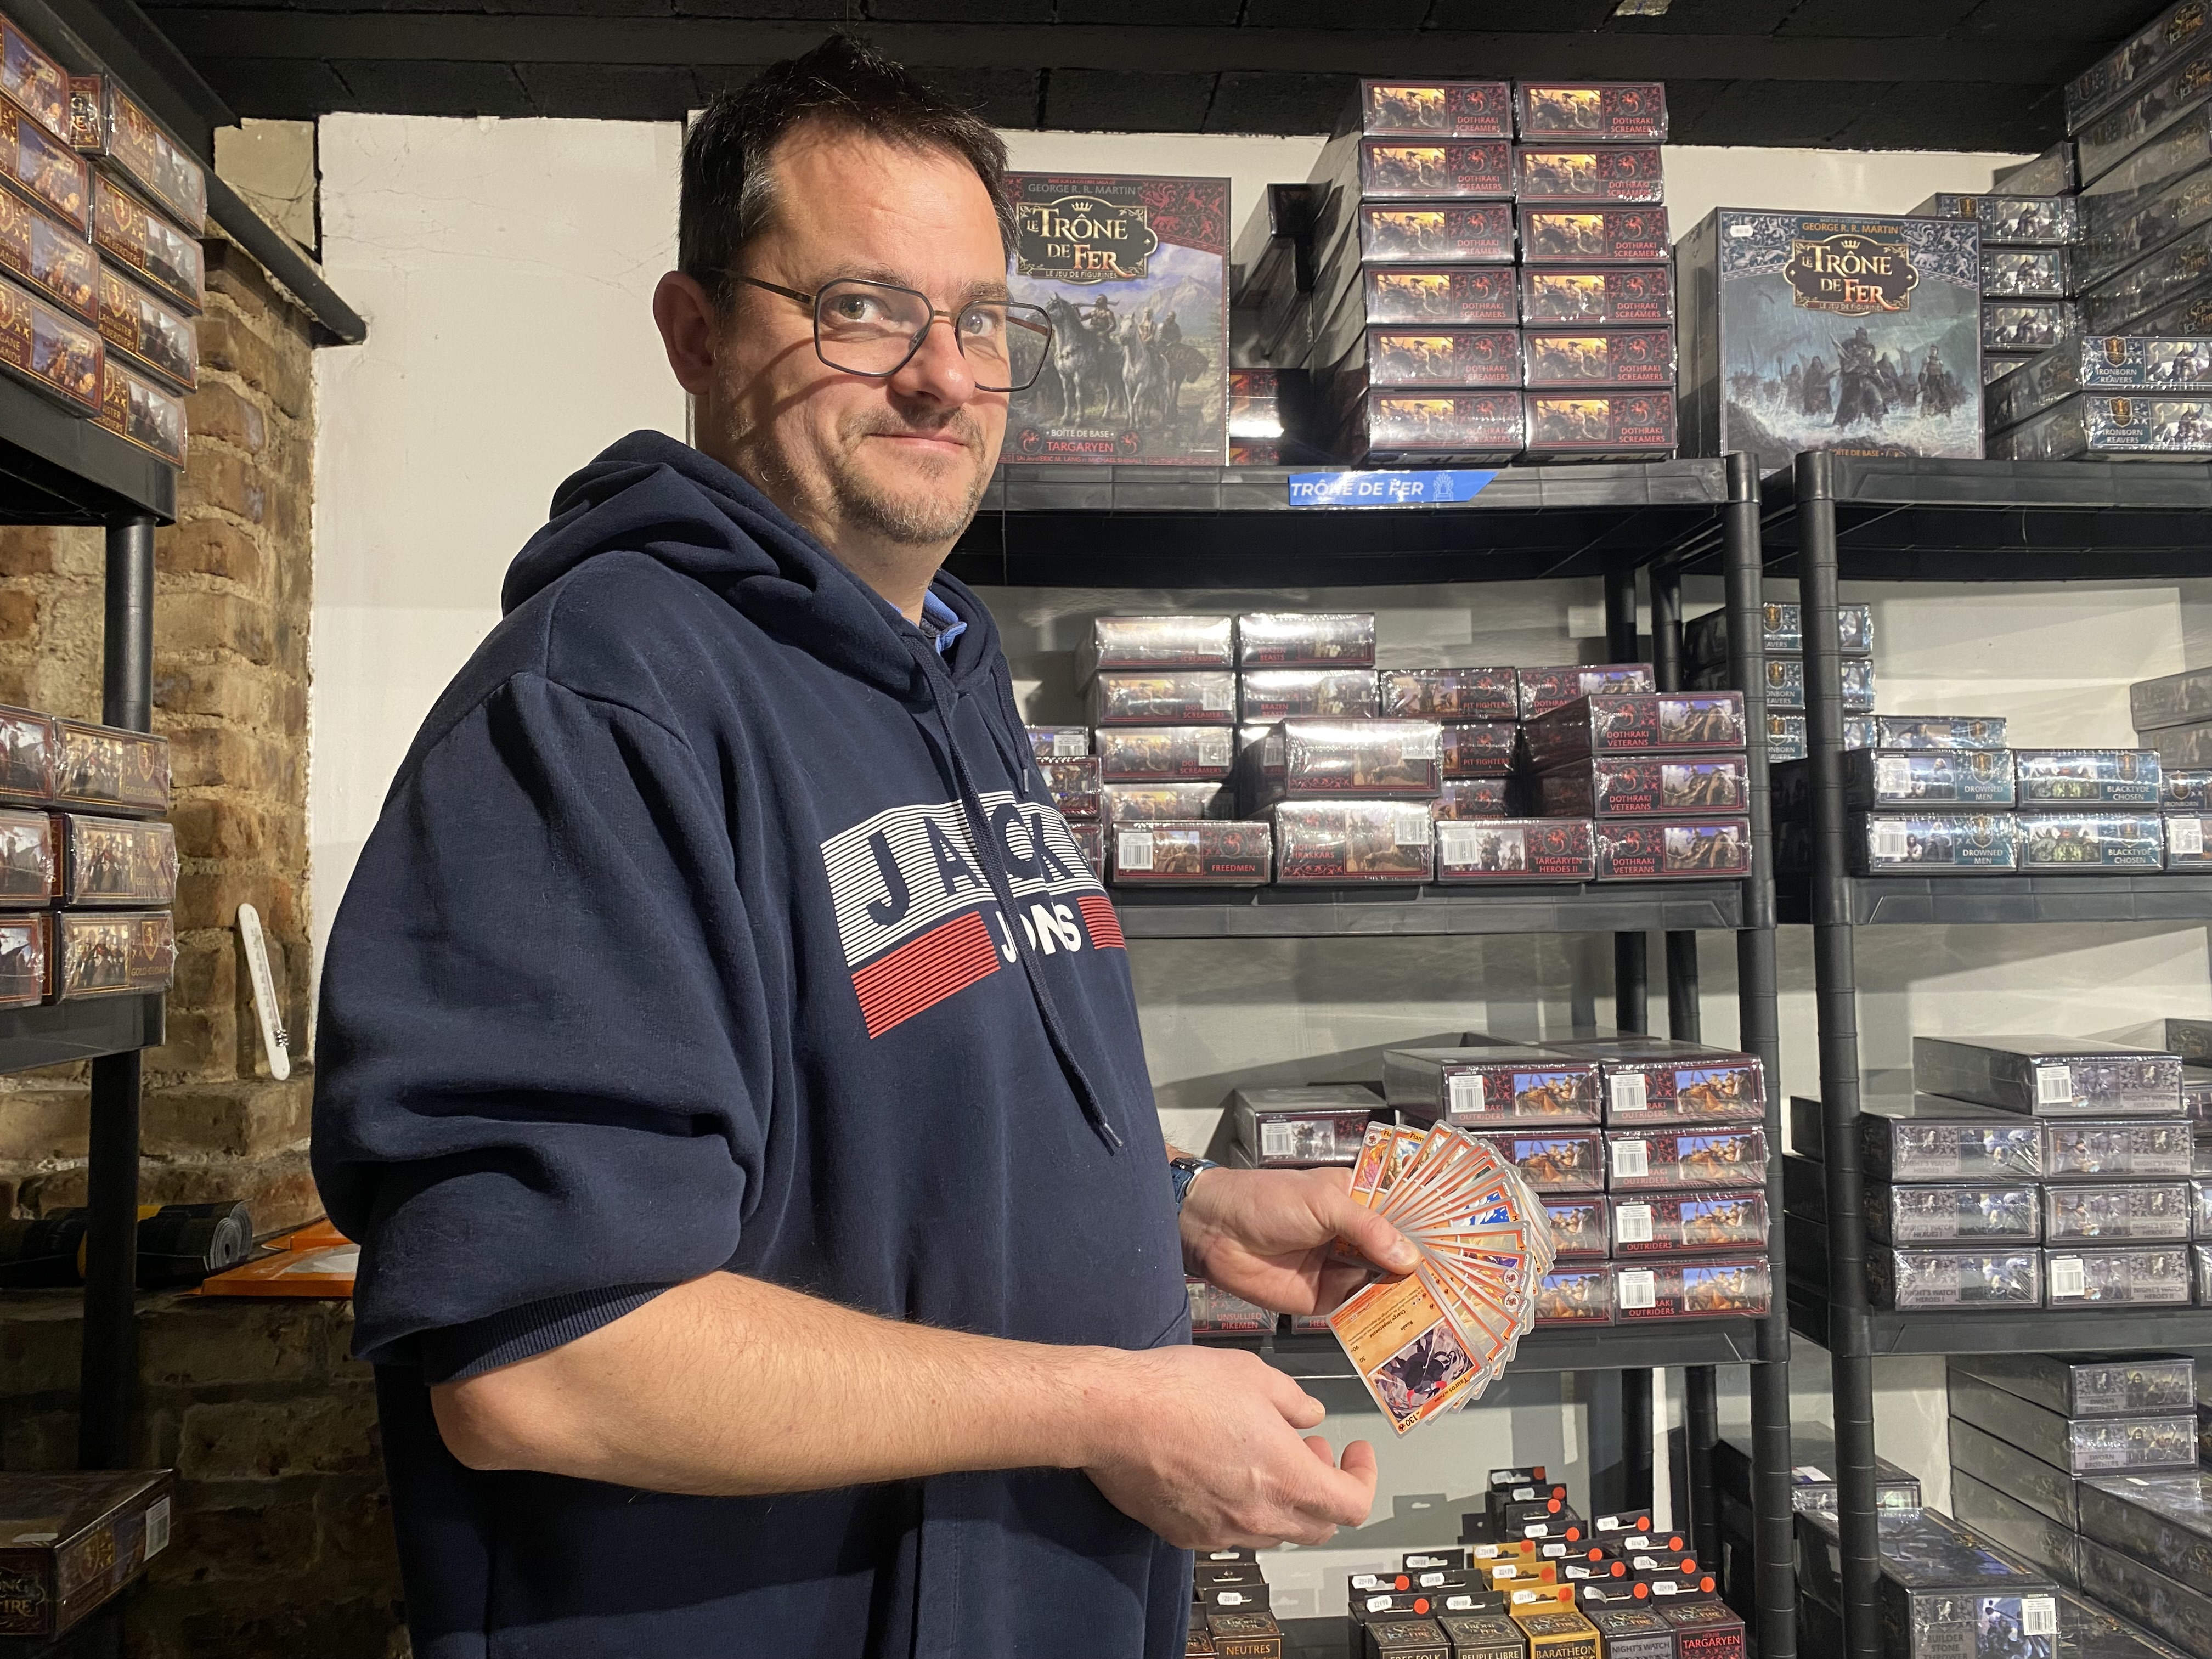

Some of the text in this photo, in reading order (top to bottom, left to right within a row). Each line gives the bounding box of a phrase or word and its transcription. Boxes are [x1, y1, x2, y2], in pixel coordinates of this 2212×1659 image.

[1028, 183, 1136, 195] GEORGE R. R. MARTIN
[1026, 208, 1128, 242] LE TRÔNE
[1802, 223, 1838, 232] GEORGE
[1862, 225, 1898, 234] MARTIN
[1047, 244, 1136, 278] DE FER
[1802, 246, 1893, 276] LE TRÔNE
[1820, 278, 1900, 311] DE FER
[1616, 310, 1661, 318] SCREAMERS
[0, 331, 20, 352] GANE
[0, 345, 21, 364] ANDS
[1617, 373, 1663, 381] SCREAMERS
[1052, 428, 1075, 437] BOÎTE
[1090, 430, 1109, 438] BASE
[1622, 427, 1663, 435] DOTHRAKI
[1046, 441, 1114, 453] TARGARYEN
[1358, 481, 1424, 496] DE FER
[126, 786, 142, 794] GOLD
[866, 803, 1075, 927] JACK
[131, 968, 148, 977] GOLD
[1459, 1113, 1505, 1121] OUTRIDERS
[1621, 1110, 1668, 1119] OUTRIDERS
[1623, 1176, 1669, 1185] OUTRIDERS
[1627, 1242, 1672, 1250] OUTRIDERS
[1217, 1313, 1262, 1321] UNSULLIED
[1392, 1309, 1407, 1321] Charge
[1629, 1308, 1674, 1316] OUTRIDERS
[1400, 1319, 1414, 1331] Ruade
[1449, 1377, 1469, 1392] Tauros
[1404, 1413, 1418, 1427] 130
[1683, 1635, 1740, 1649] TARGARYEN
[1927, 1634, 1963, 1643] BUILDER
[1227, 1644, 1271, 1655] NEUTRES
[1536, 1645, 1596, 1659] BARATHEON
[1612, 1641, 1670, 1653] NIGHT'S WATCH
[1496, 1651, 1519, 1659] LIBRE
